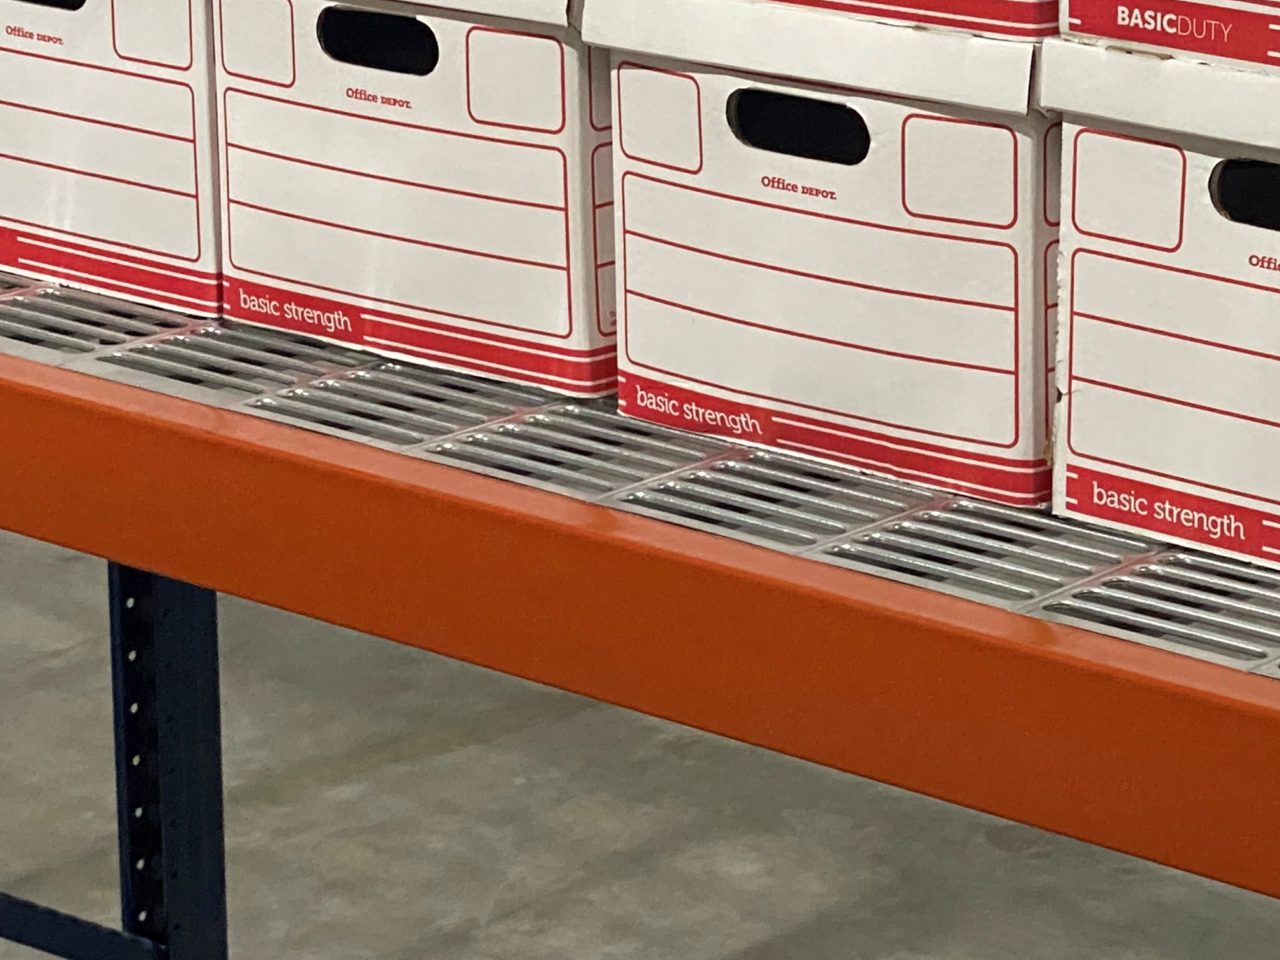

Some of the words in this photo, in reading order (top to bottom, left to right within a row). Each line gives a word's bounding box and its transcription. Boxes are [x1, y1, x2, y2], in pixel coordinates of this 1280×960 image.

[5, 25, 34, 39] Office
[346, 87, 379, 104] Office
[761, 176, 798, 192] Office
[239, 288, 280, 317] basic
[283, 301, 353, 333] strength
[636, 384, 680, 417] basic
[682, 401, 763, 435] strength
[1092, 480, 1149, 516] basic
[1153, 499, 1246, 541] strength
